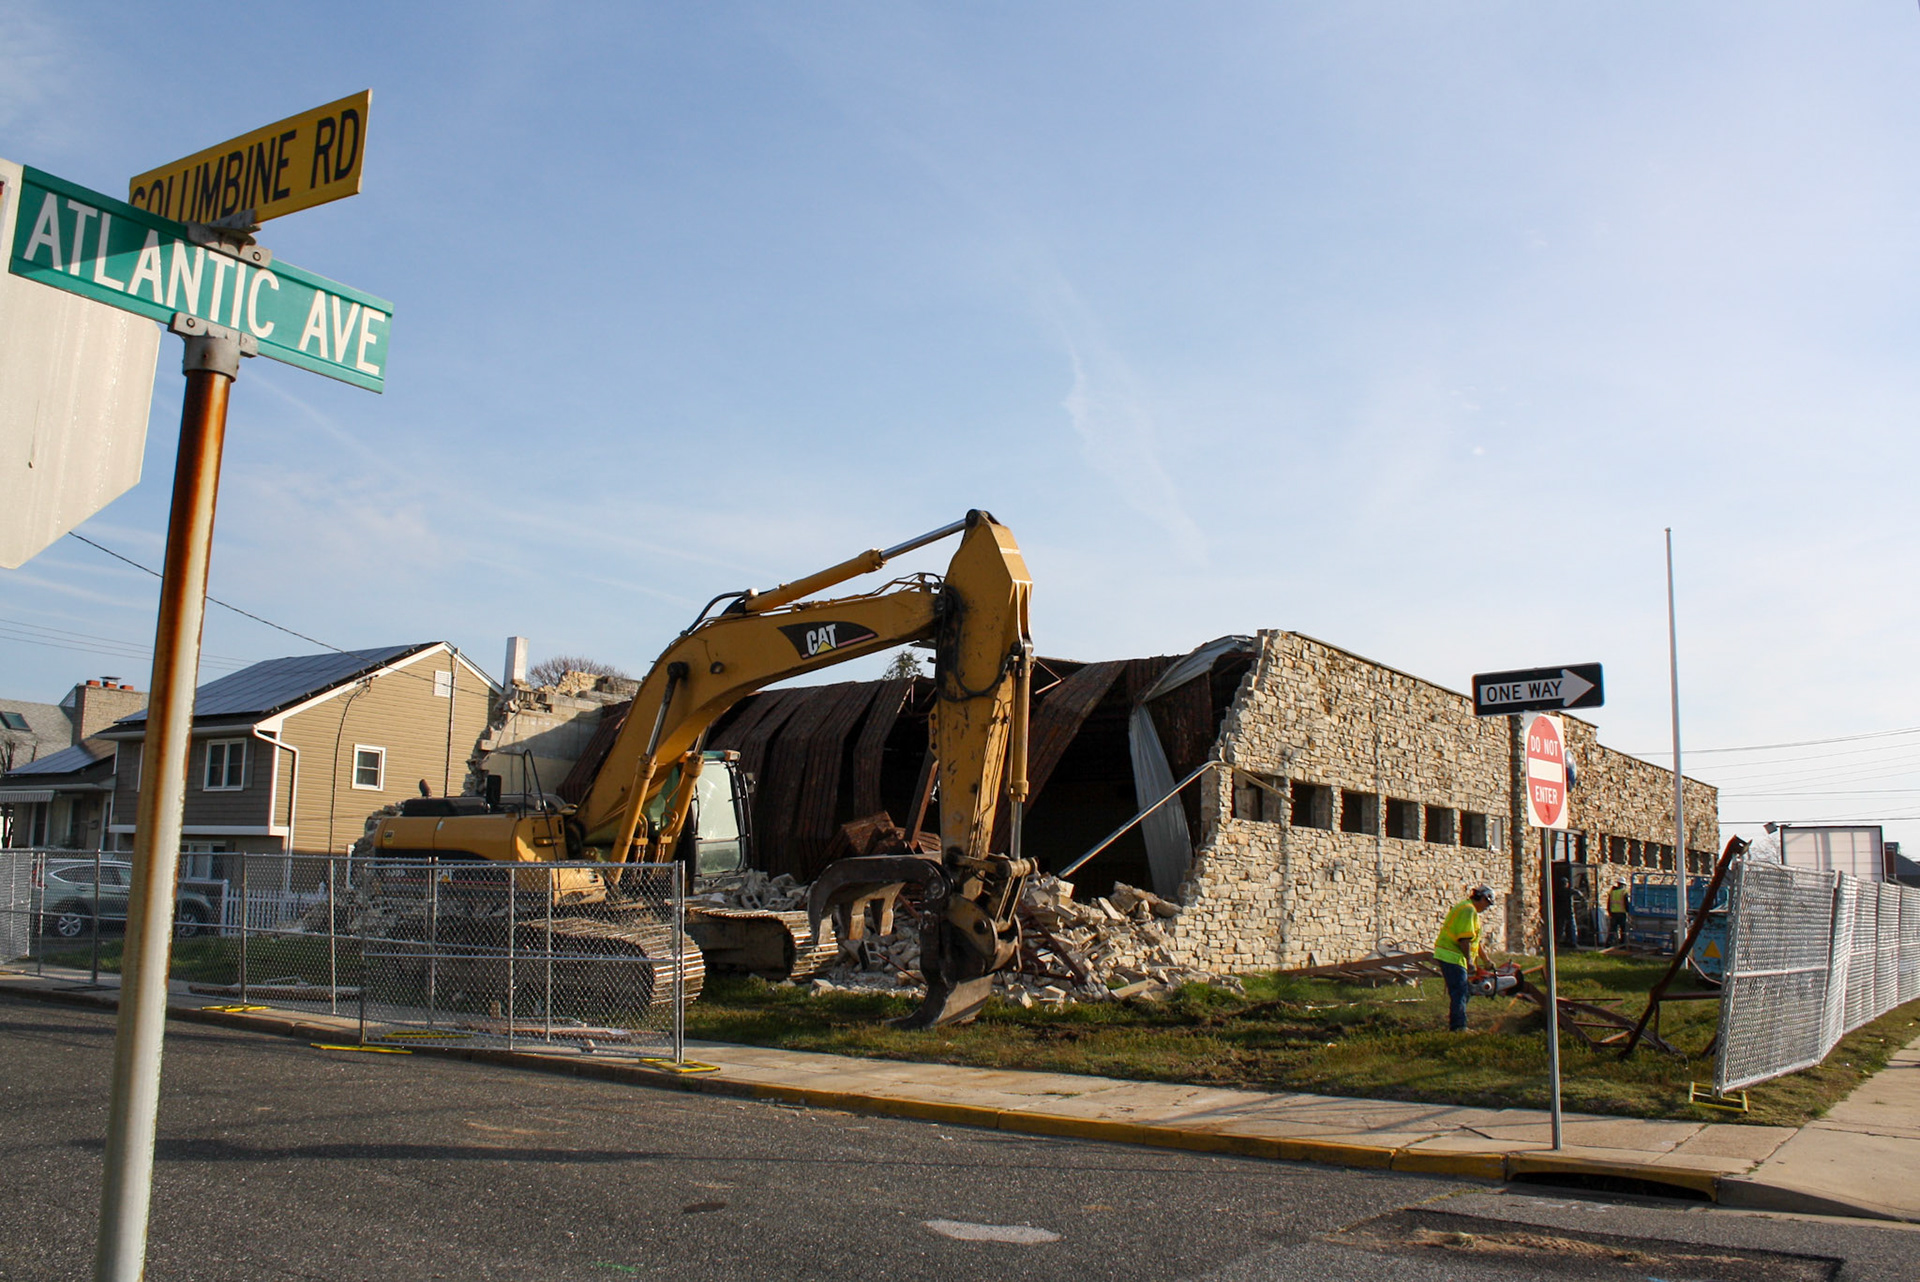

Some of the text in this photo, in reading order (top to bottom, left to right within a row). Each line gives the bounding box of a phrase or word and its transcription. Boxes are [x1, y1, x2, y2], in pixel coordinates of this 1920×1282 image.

[310, 108, 361, 190] RD
[24, 192, 386, 375] ATLANTIC AVE
[806, 623, 837, 655] CAT
[1486, 680, 1562, 703] ONE WAY
[1530, 735, 1559, 757] DO NOT
[1535, 786, 1558, 804] ENTER
